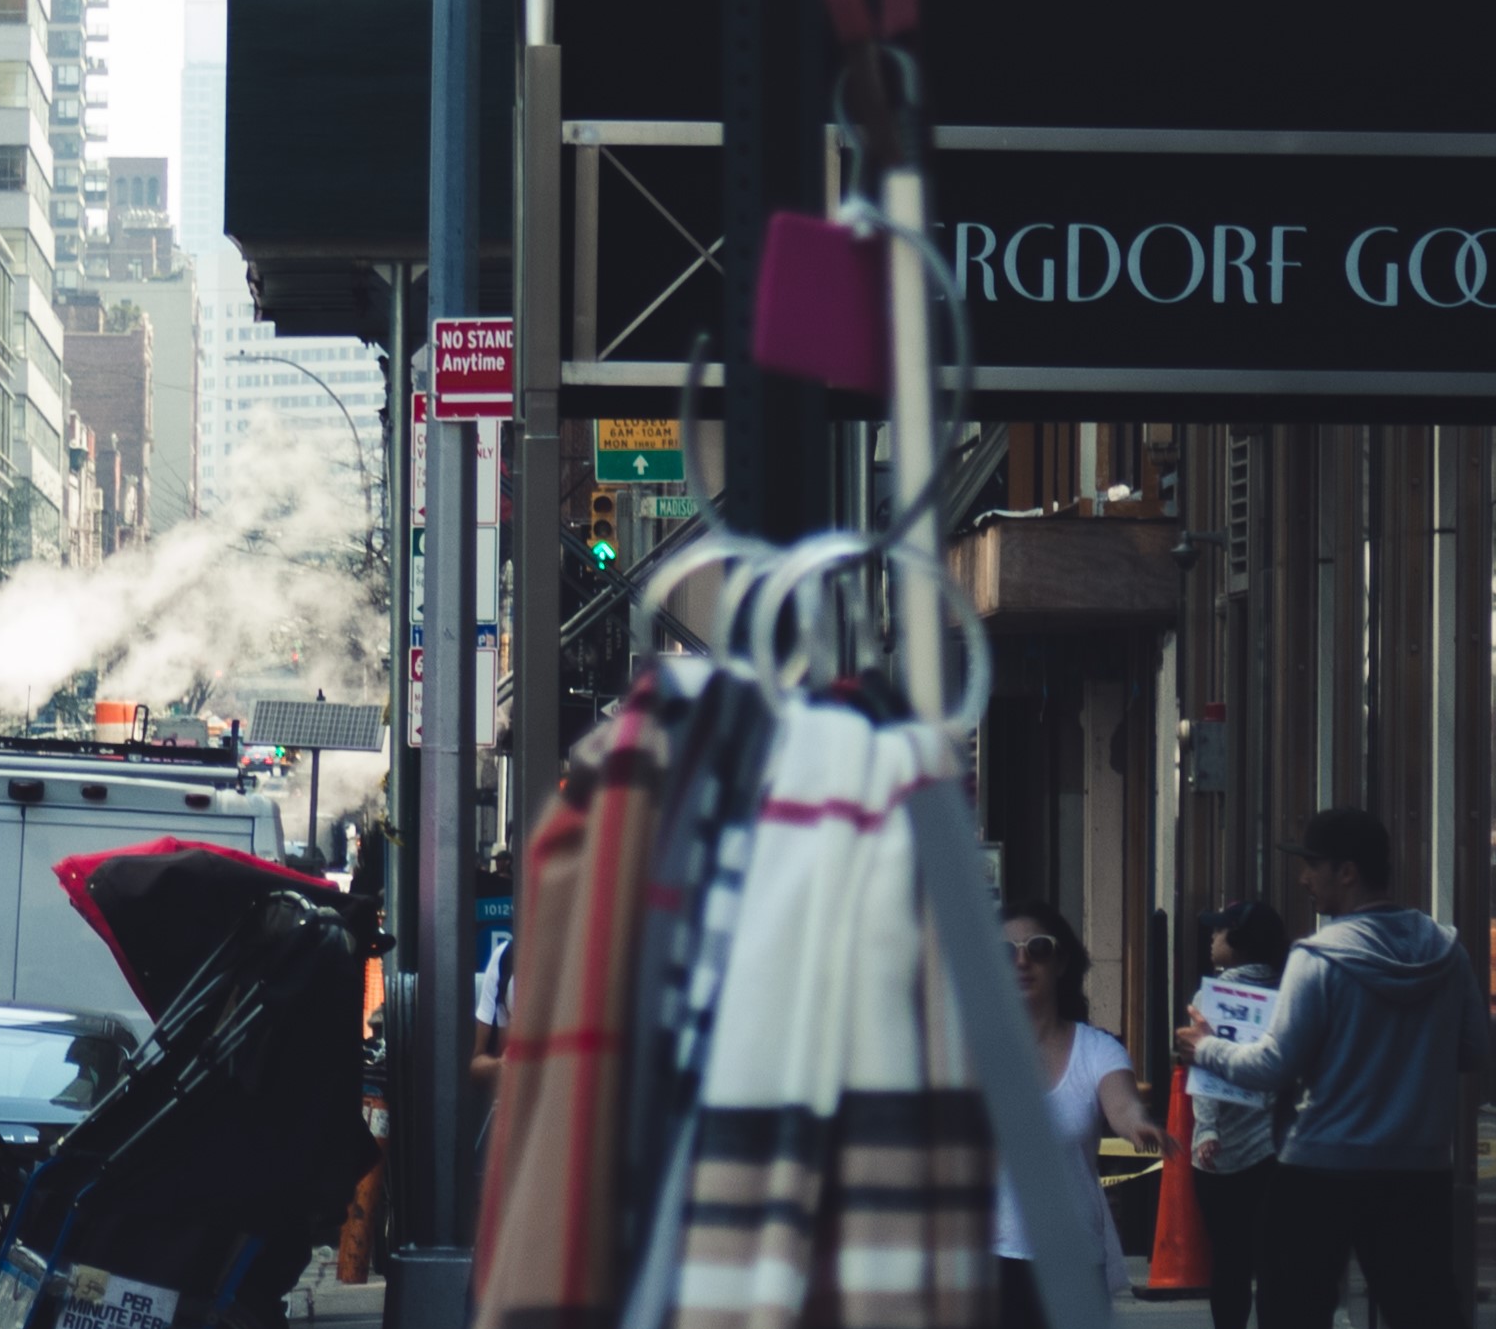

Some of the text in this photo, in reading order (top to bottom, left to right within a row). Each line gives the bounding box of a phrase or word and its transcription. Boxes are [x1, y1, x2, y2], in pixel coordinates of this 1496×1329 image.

[932, 222, 1307, 304] RGDORF
[441, 330, 513, 350] NO STAND
[442, 352, 505, 372] Anytime
[603, 438, 629, 449] MON
[661, 438, 679, 449] FRI
[484, 904, 513, 916] 1012
[67, 1296, 129, 1326] MINUTE
[121, 1291, 154, 1314] PER
